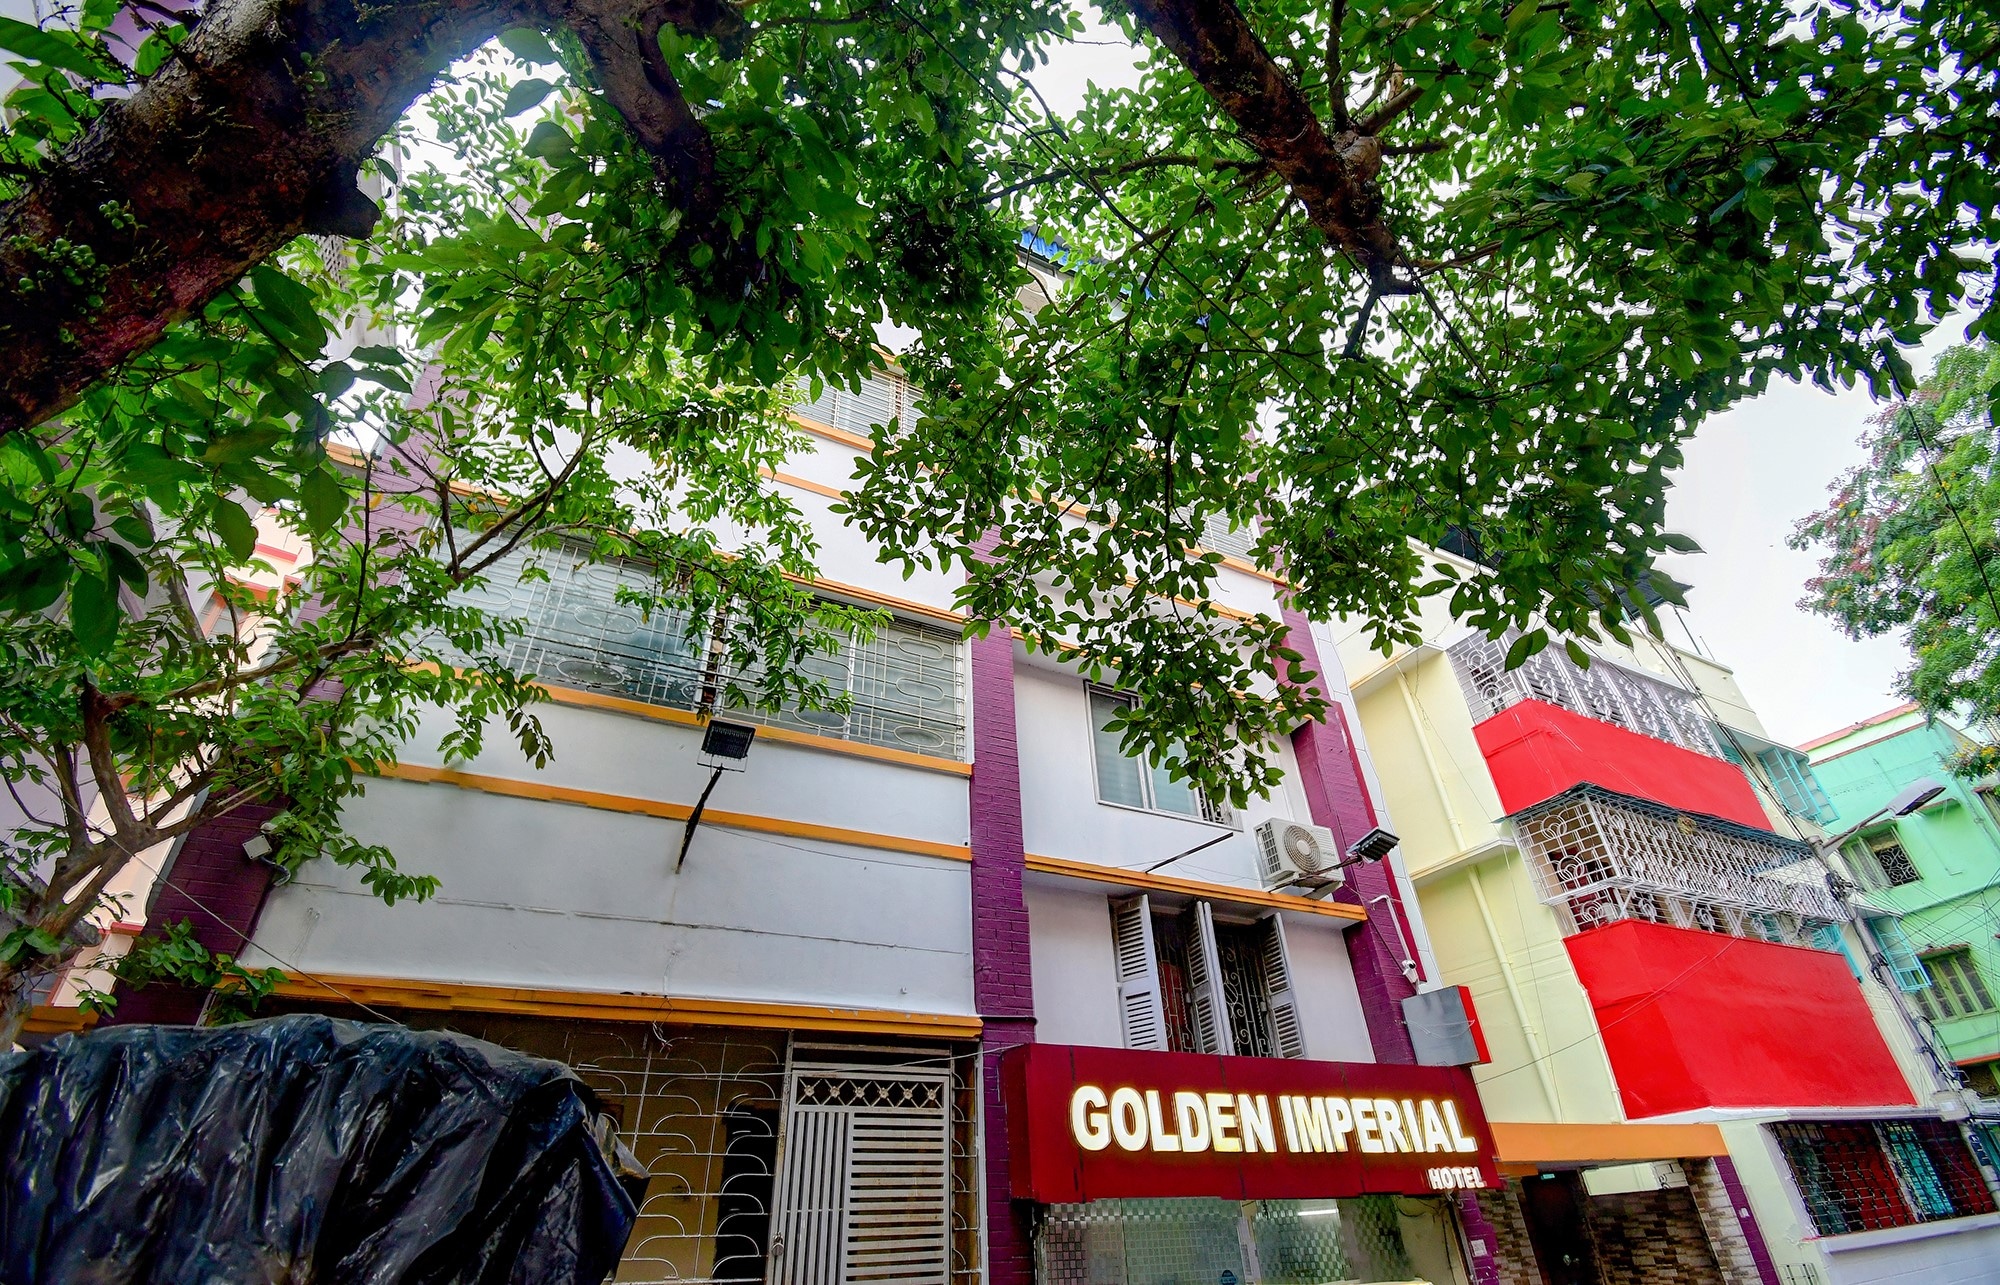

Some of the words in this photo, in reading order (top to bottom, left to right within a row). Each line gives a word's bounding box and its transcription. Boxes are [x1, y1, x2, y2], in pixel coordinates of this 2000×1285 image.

[1071, 1085, 1277, 1153] GOLDEN
[1279, 1095, 1478, 1153] IMPERIAL
[1427, 1166, 1486, 1190] HOTEL
